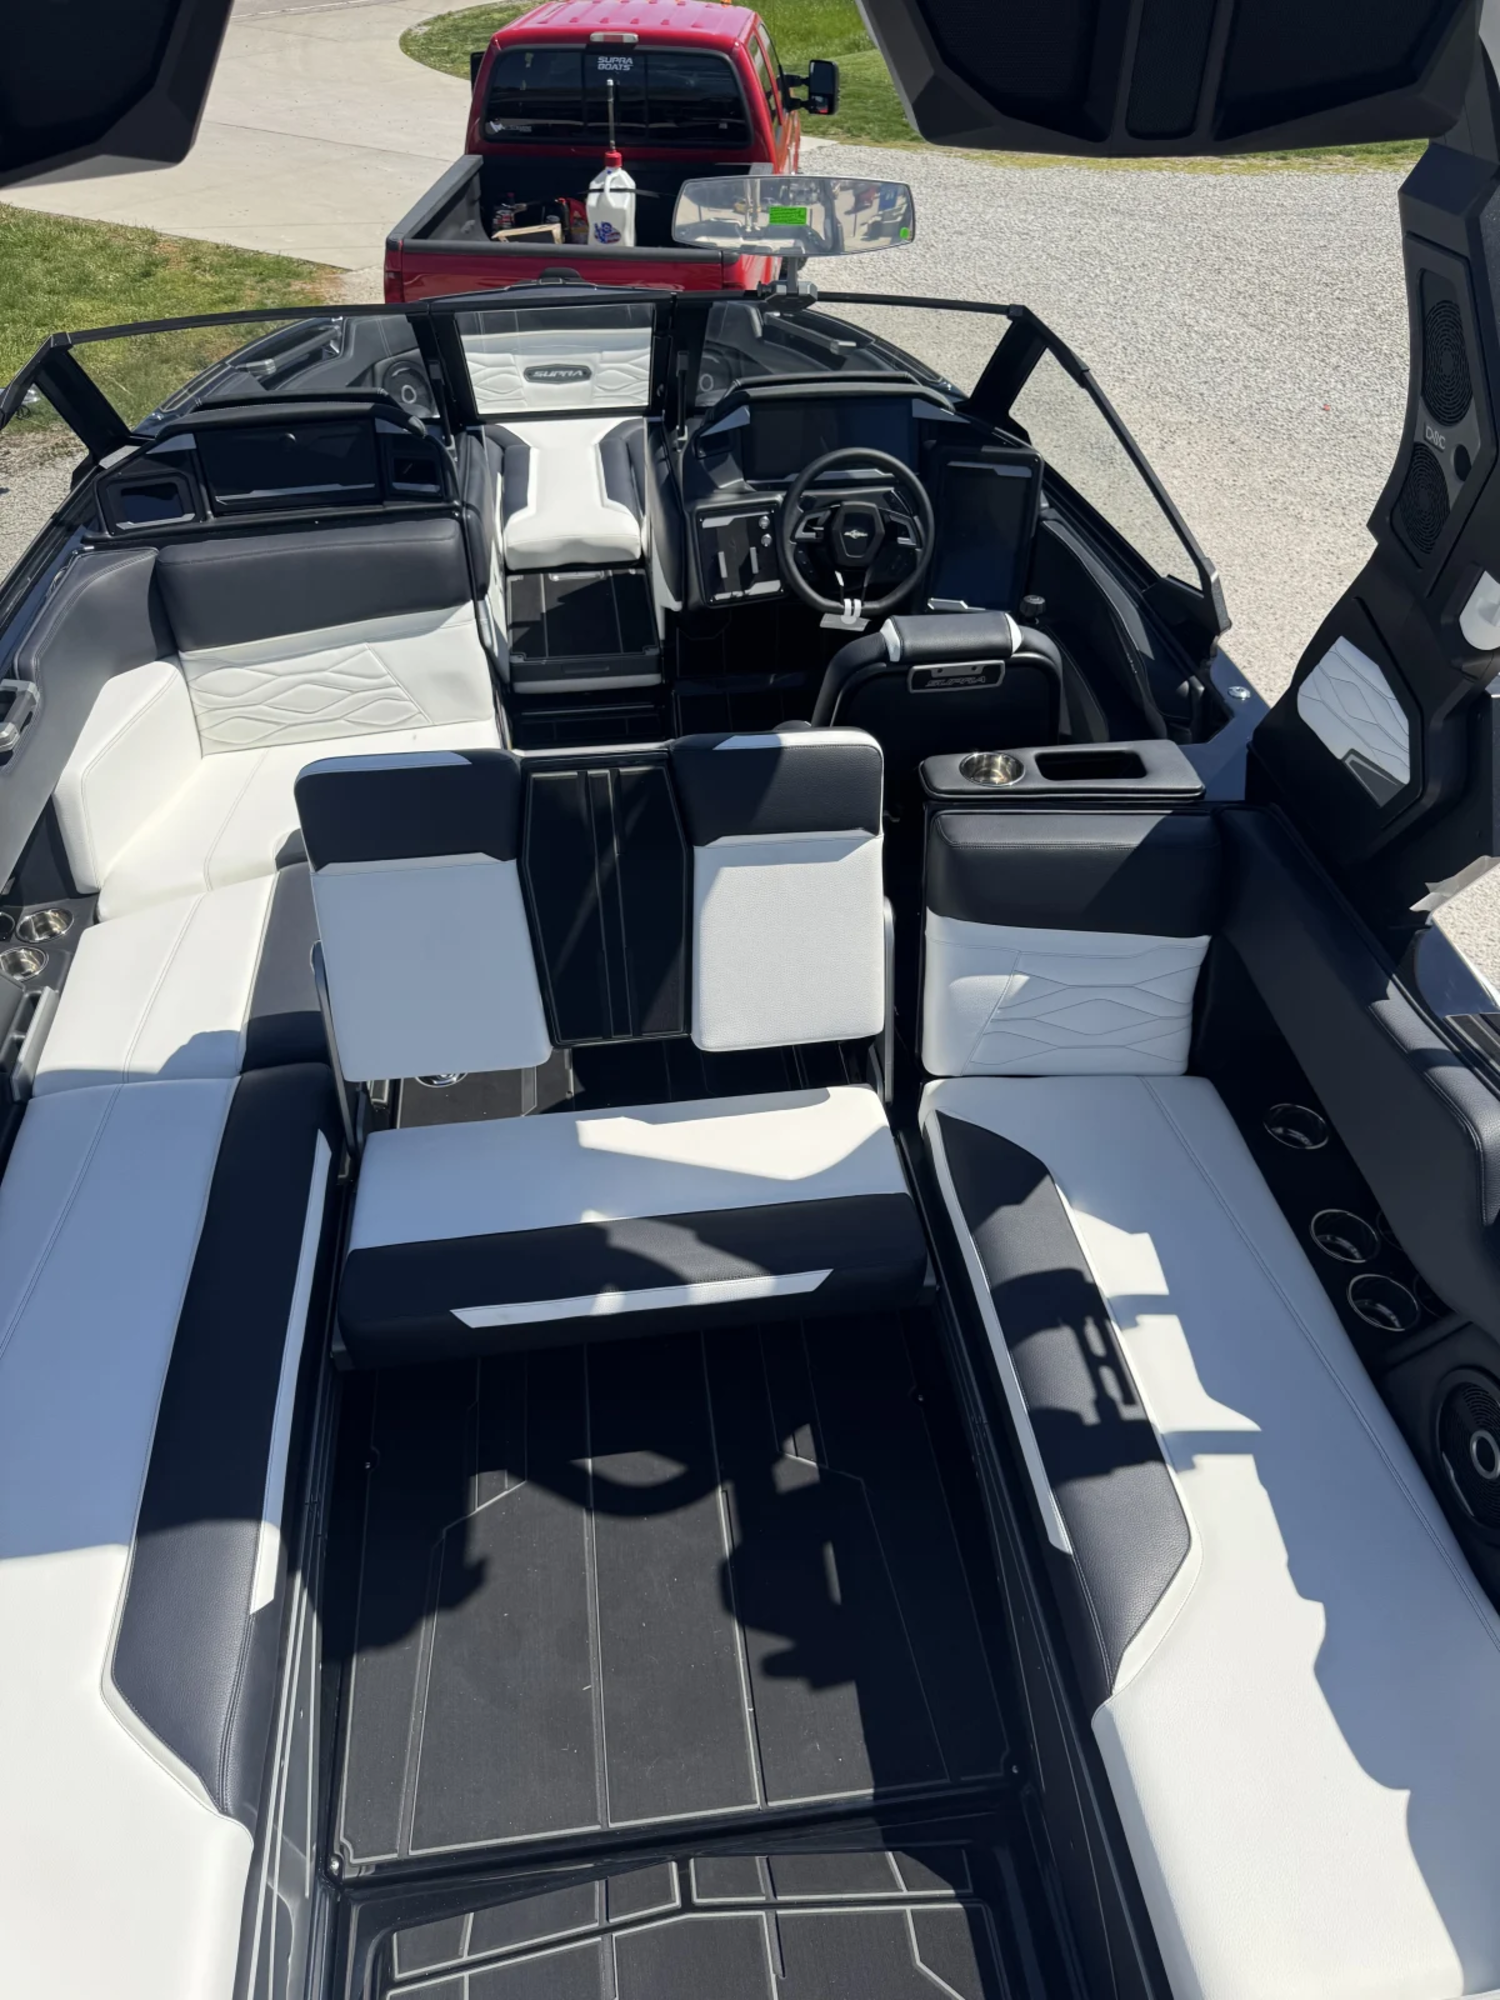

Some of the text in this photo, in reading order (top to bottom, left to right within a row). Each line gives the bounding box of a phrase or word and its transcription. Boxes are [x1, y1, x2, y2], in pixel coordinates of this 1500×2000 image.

[597, 56, 633, 64] SUPRA
[597, 63, 634, 71] BOATS
[532, 370, 583, 378] SUPRA
